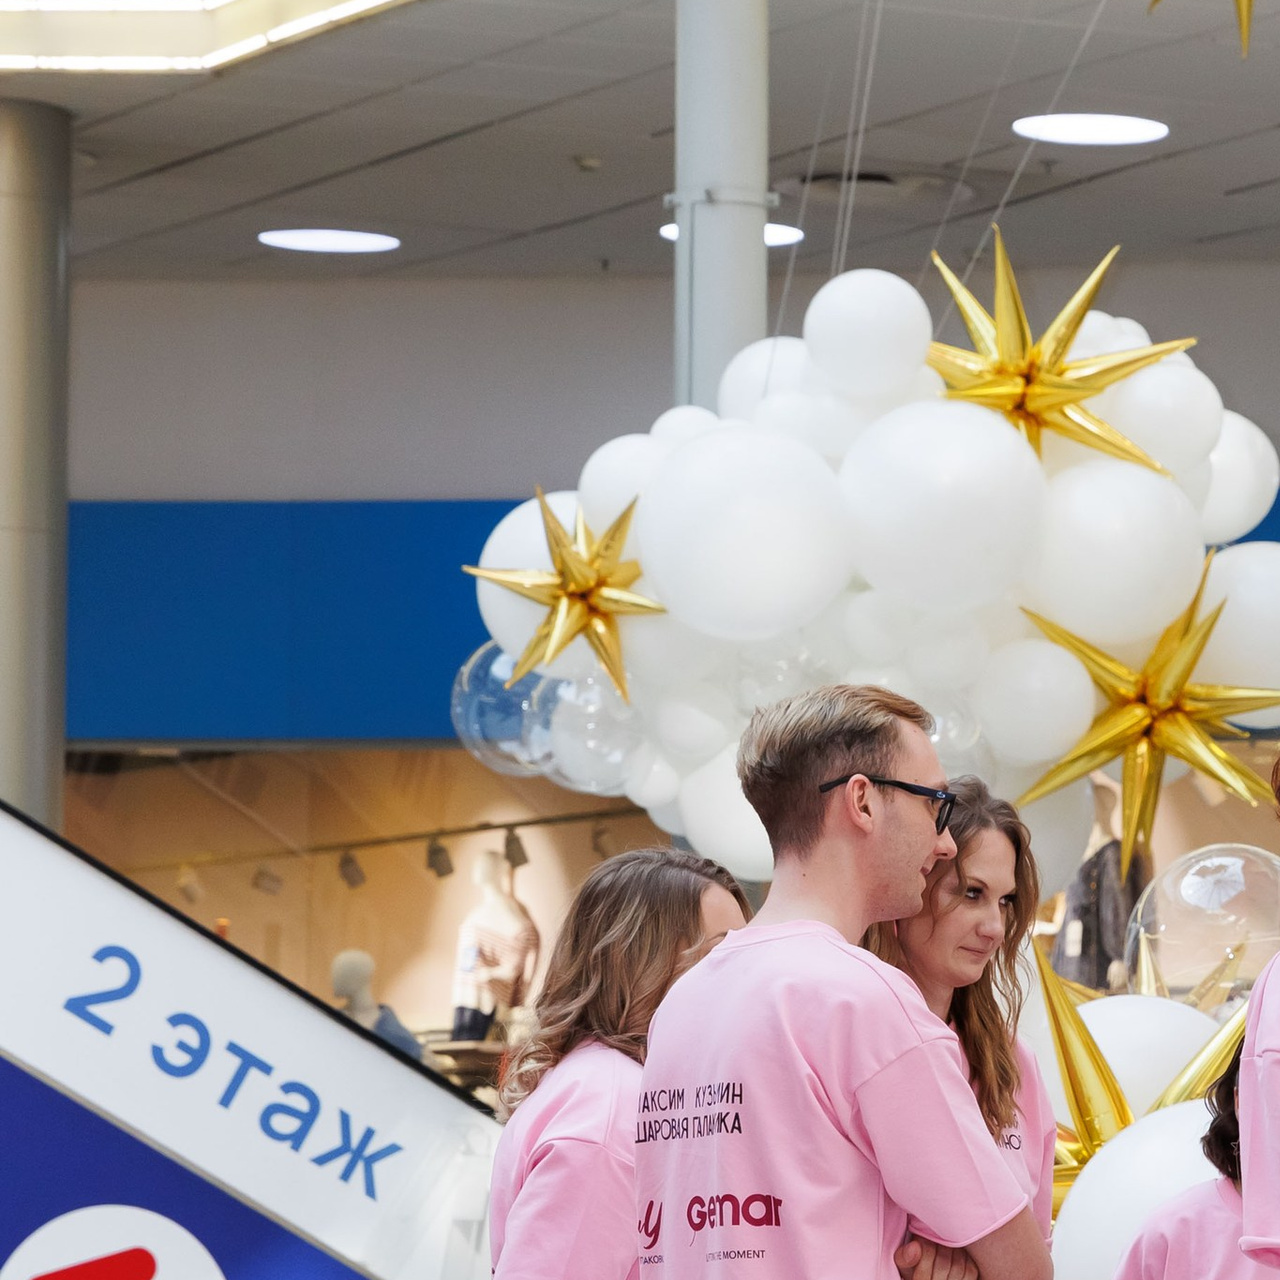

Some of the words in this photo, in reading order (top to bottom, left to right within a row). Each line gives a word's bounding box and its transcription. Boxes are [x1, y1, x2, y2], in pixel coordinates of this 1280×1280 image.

[63, 945, 142, 1036] 2
[151, 1013, 403, 1202] этаж
[722, 1249, 766, 1260] MOMENT
